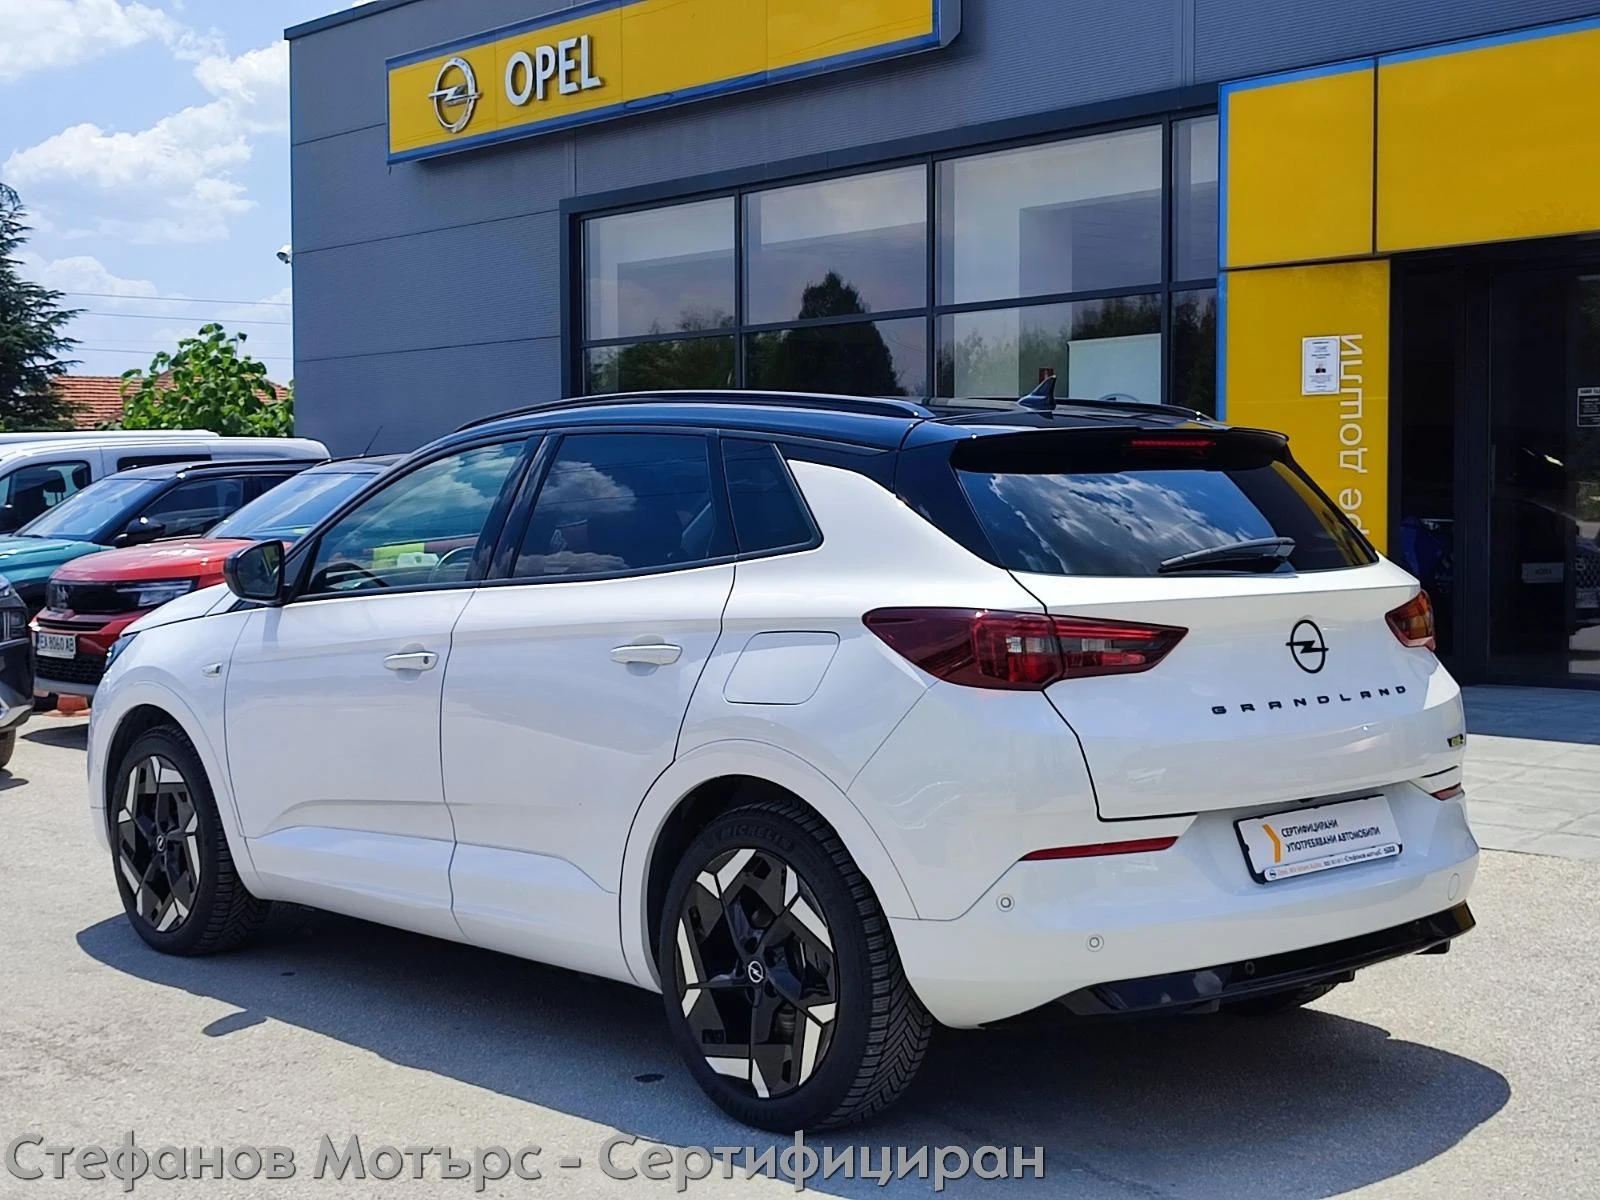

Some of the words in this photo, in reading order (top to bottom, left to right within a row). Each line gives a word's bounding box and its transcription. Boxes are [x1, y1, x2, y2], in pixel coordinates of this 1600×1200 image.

[504, 33, 605, 107] OPEL
[1339, 334, 1368, 474] дошли
[1211, 685, 1407, 715] GRANDLAND
[1281, 818, 1339, 838] СЕРТИФИЦИРАНИ
[1286, 834, 1338, 853] УПОТРЕБЯВАНИ
[1338, 826, 1381, 843] АВТОМОБИЛИ
